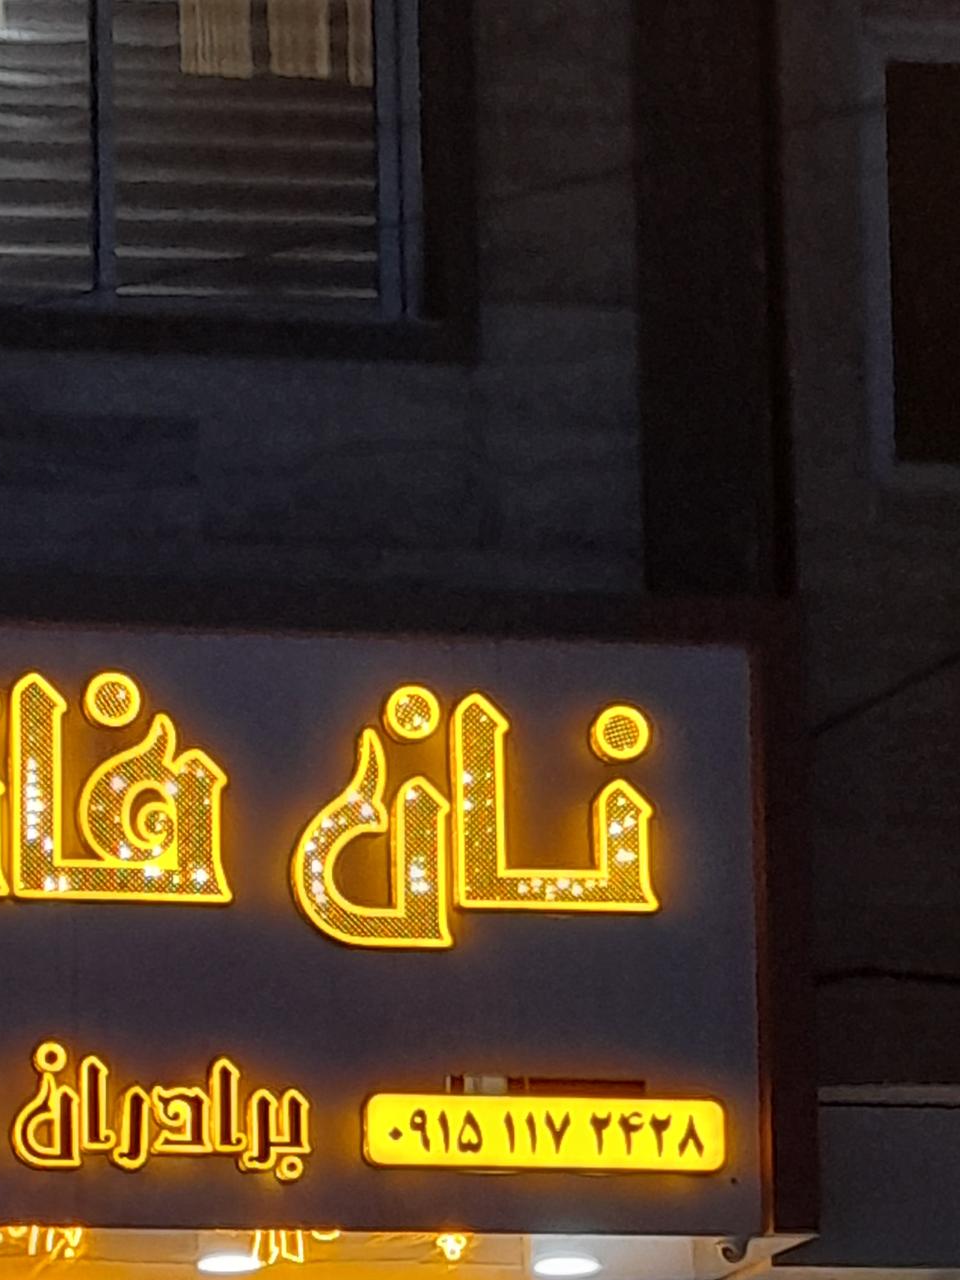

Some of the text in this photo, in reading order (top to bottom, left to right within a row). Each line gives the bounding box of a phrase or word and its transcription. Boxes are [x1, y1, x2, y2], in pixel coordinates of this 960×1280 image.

[290, 684, 660, 948] نان
[13, 1041, 312, 1180] برادران
[389, 1109, 704, 1157] ۰۹۱۵ ۱۱۷ ۲۴۲۸
